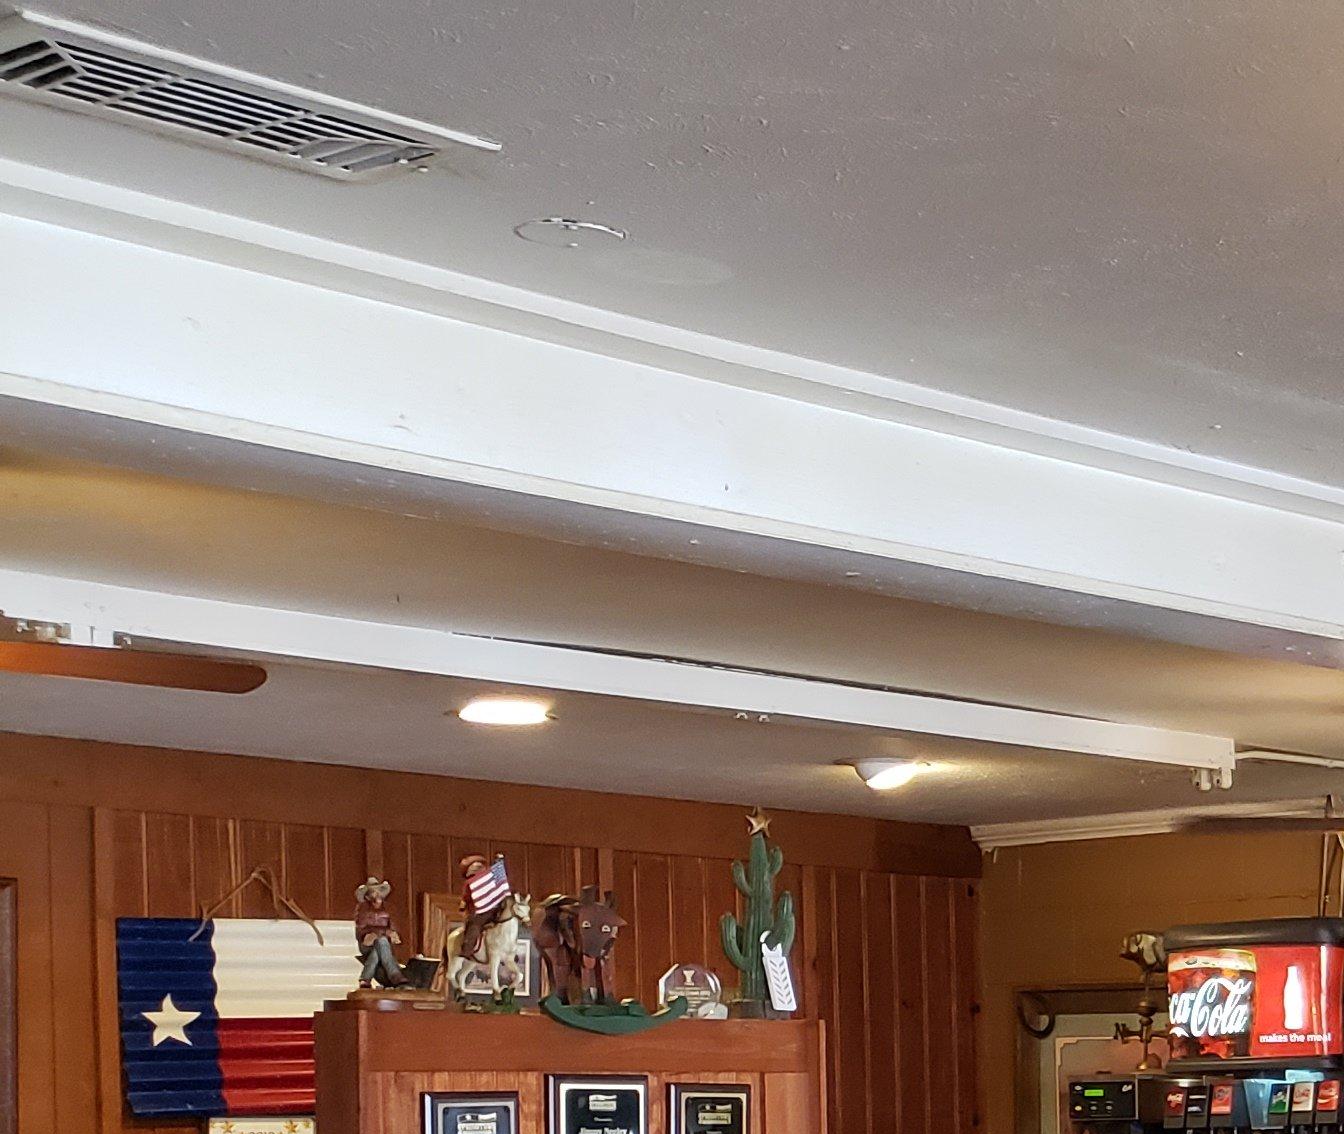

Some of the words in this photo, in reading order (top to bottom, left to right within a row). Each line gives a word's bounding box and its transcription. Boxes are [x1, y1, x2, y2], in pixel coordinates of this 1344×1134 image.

[1168, 977, 1252, 1037] ca-Cola
[1259, 1033, 1289, 1043] makes
[1290, 1033, 1305, 1042] the
[1307, 1032, 1331, 1043] meal
